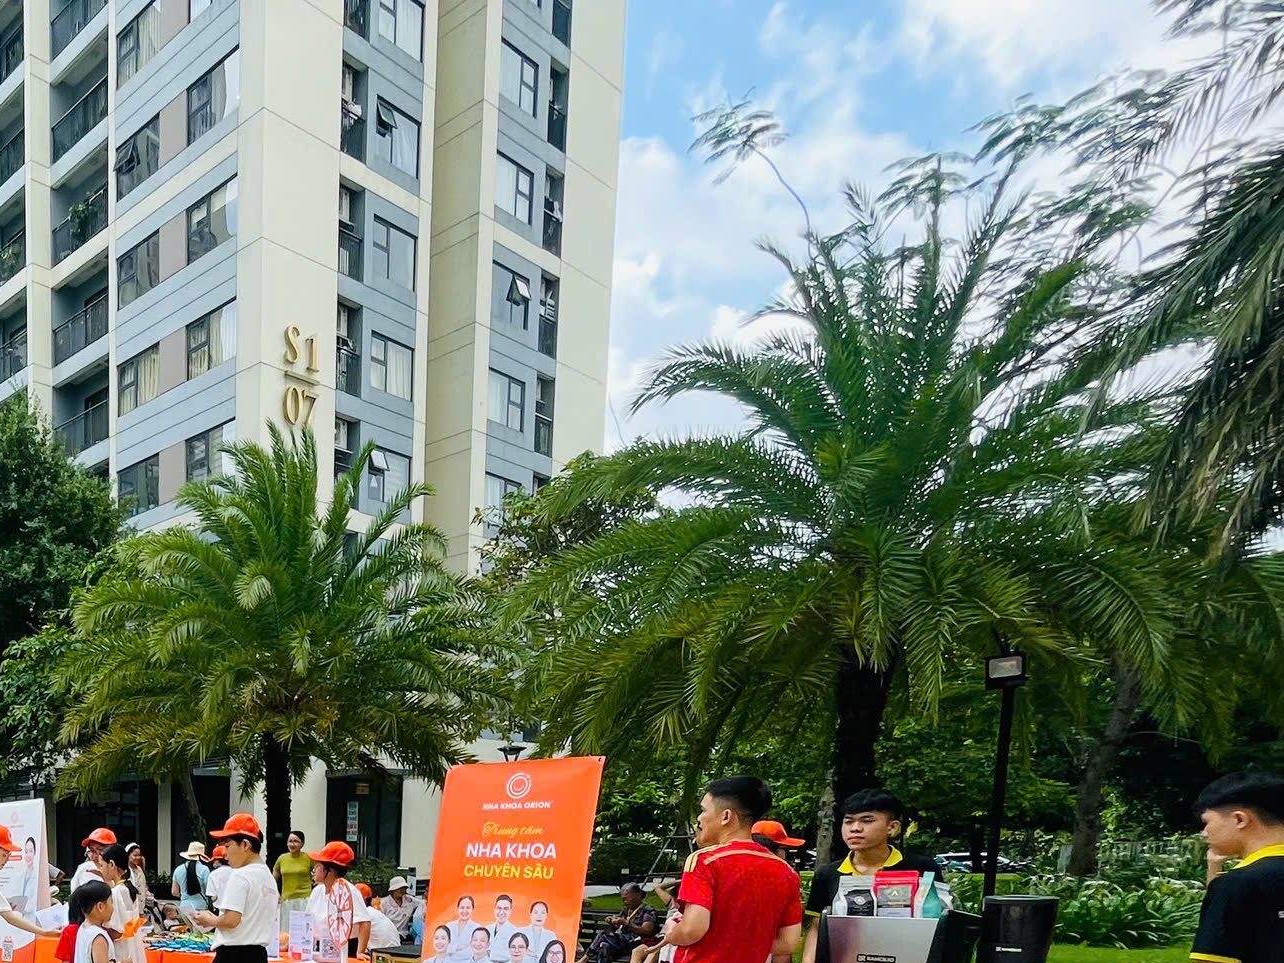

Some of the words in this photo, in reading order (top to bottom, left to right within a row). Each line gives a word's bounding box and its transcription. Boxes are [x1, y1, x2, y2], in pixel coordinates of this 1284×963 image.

[284, 325, 320, 372] S1
[283, 386, 320, 426] 07
[524, 801, 550, 809] ORION
[483, 822, 518, 838] Trung
[520, 825, 543, 835] tâm
[466, 842, 502, 858] NHA
[505, 842, 557, 859] KHOA
[464, 862, 521, 879] CHUYÊN
[523, 863, 554, 880] SÂU
